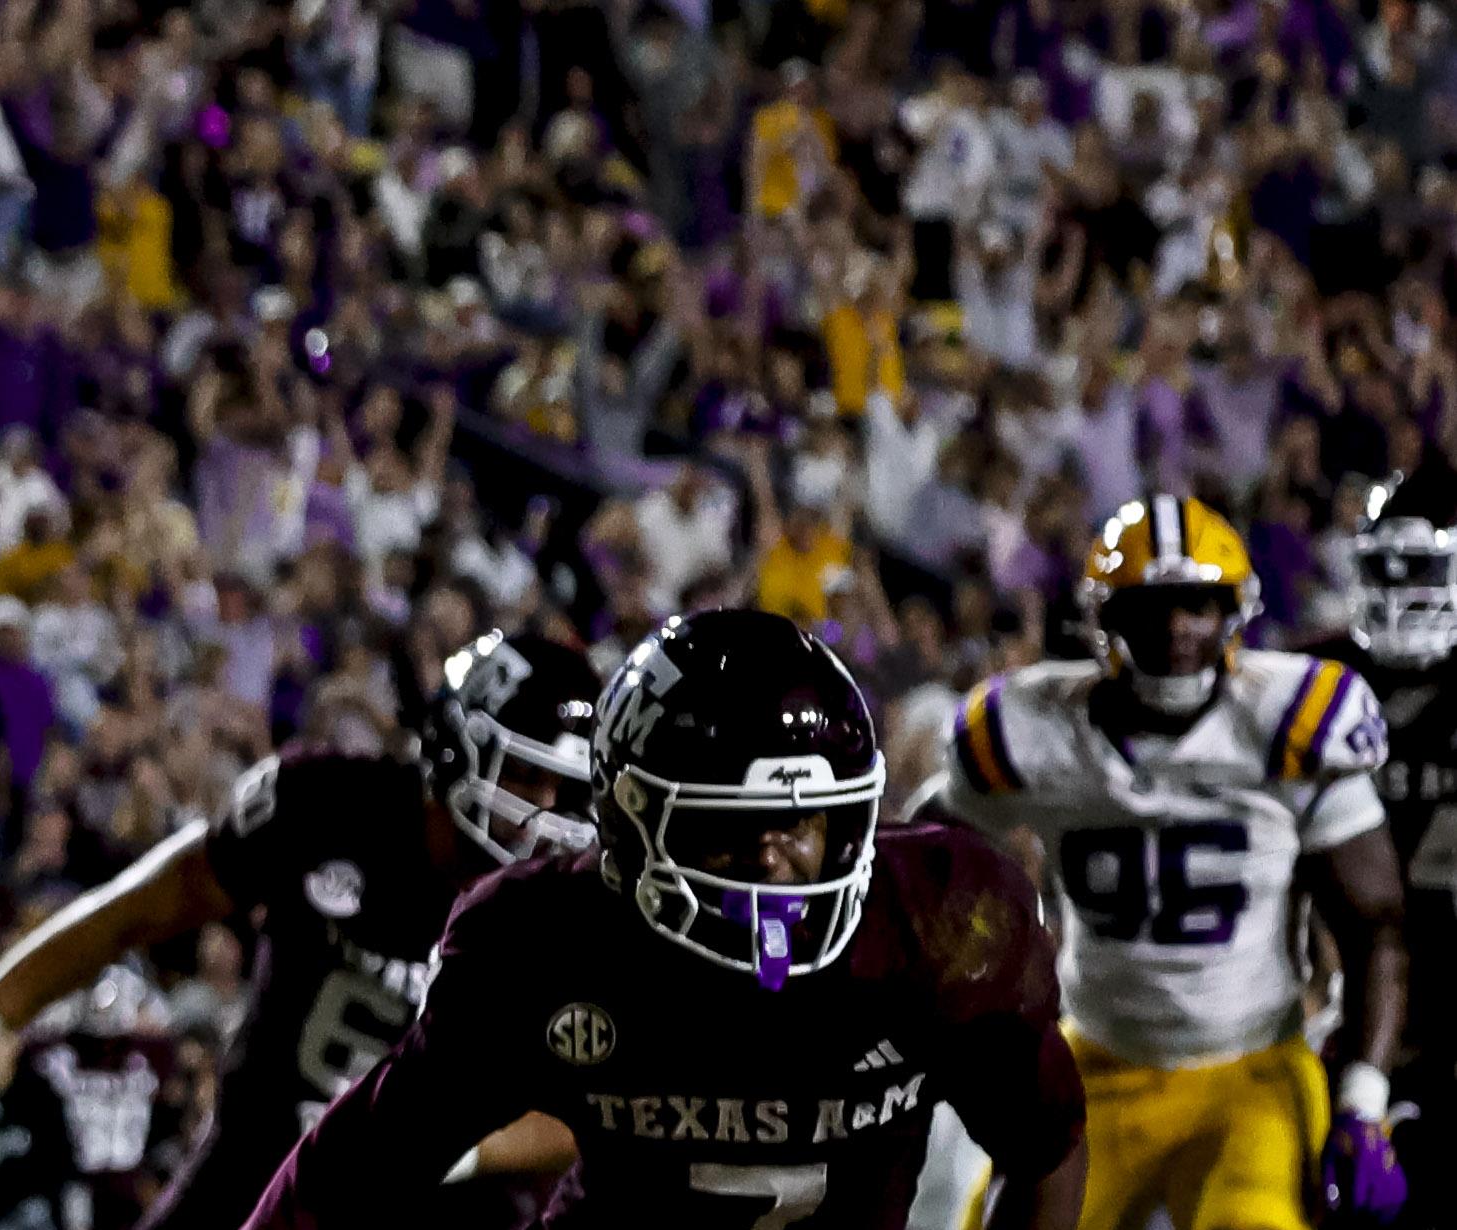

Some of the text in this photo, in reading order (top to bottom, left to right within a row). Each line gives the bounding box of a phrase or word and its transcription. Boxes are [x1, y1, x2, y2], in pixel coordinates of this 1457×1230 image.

[1060, 819, 1252, 945] 96
[551, 1006, 611, 1061] SEC
[587, 1072, 927, 1144] TEXAS A&M
